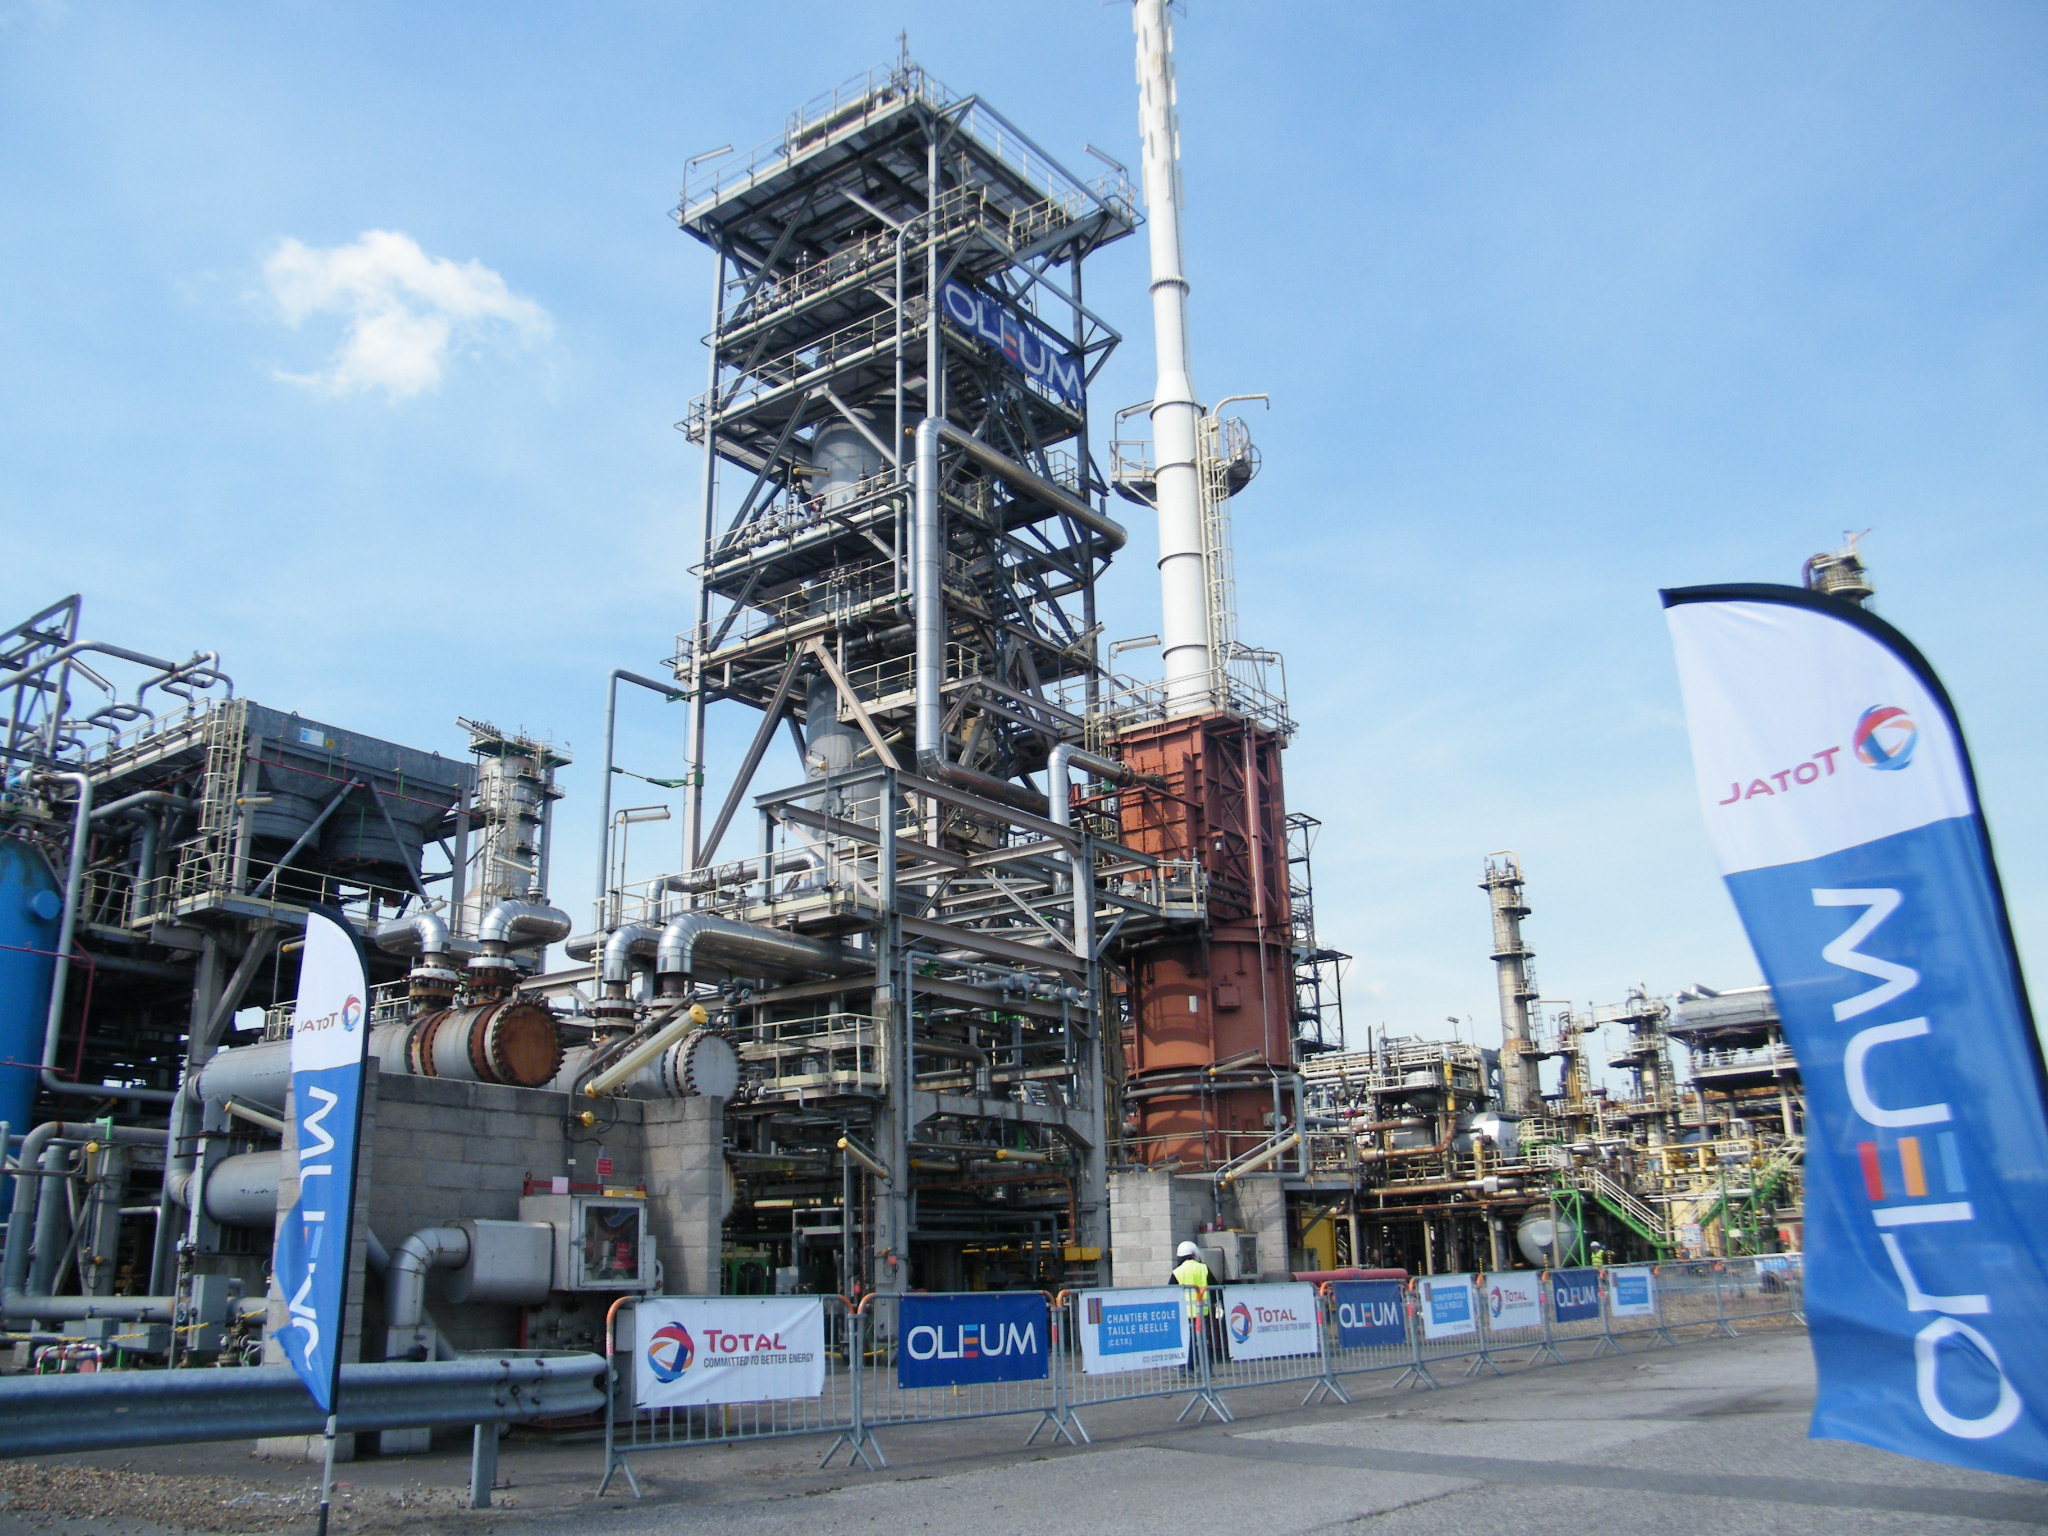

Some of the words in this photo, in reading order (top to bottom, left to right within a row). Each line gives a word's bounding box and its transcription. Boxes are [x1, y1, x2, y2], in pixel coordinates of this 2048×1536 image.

[945, 283, 1083, 400] OLEUM
[1504, 1290, 1527, 1302] TOTAL
[1556, 1285, 1597, 1307] OLEUM
[1107, 1312, 1148, 1324] CHANTIER
[1151, 1309, 1176, 1320] ECOLE
[1255, 1306, 1297, 1323] TOTAL
[1339, 1301, 1399, 1328] OLEUM
[1107, 1324, 1136, 1336] TAILLE
[1139, 1322, 1168, 1333] REELLE
[703, 1329, 787, 1354] TOTAL
[907, 1321, 1037, 1360] OLEUM
[703, 1356, 749, 1369] COMMITTED
[750, 1356, 759, 1366] TO
[760, 1354, 787, 1365] BETTER
[789, 1352, 814, 1363] ENERGY
